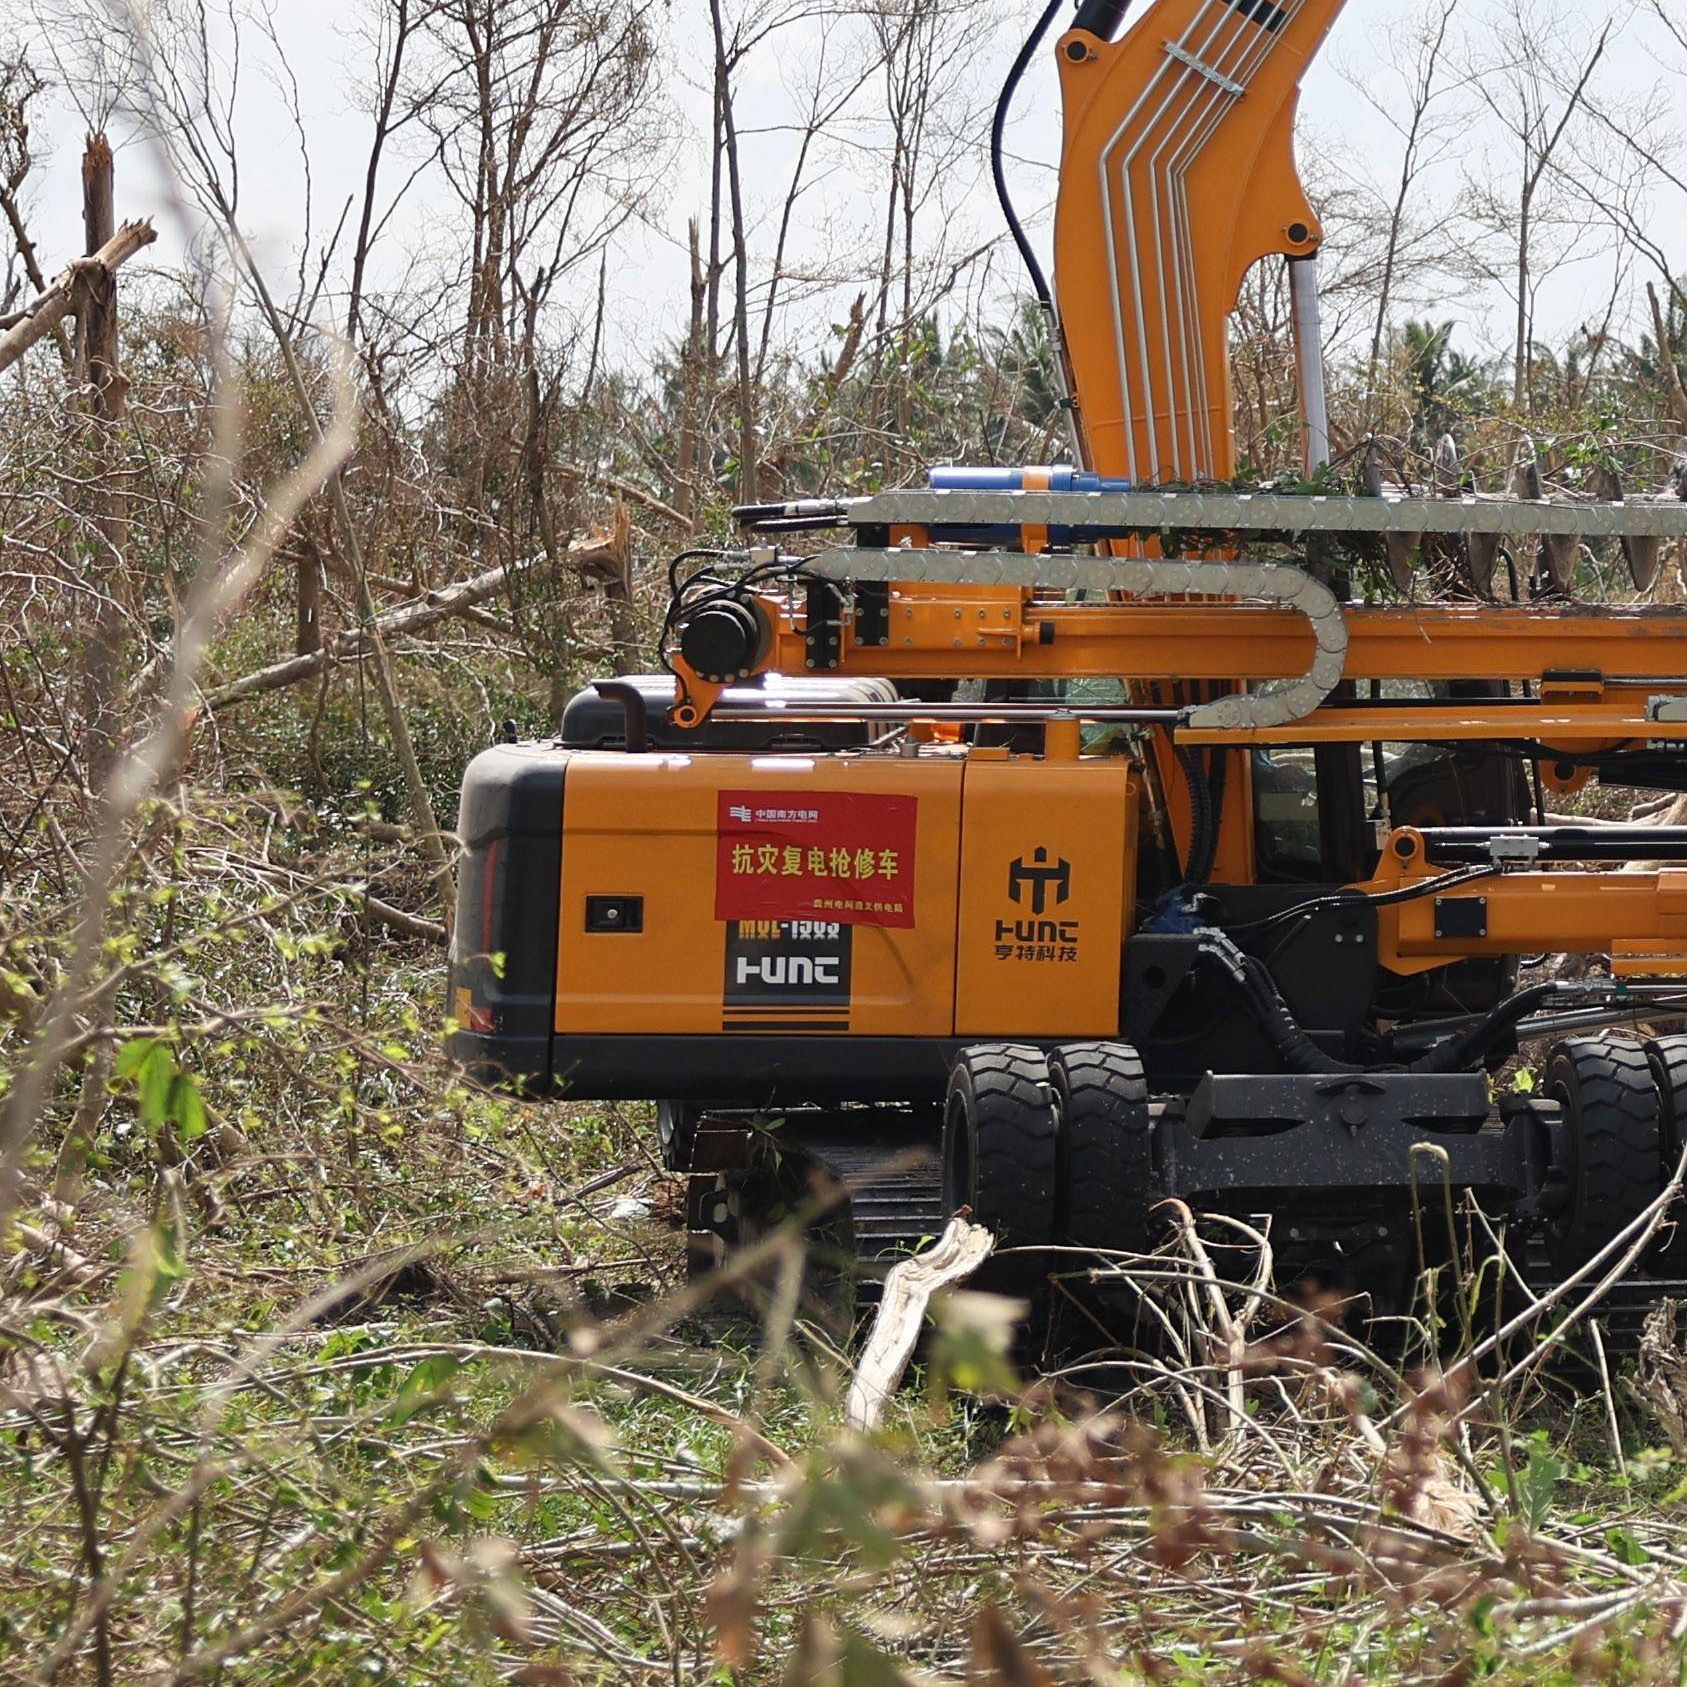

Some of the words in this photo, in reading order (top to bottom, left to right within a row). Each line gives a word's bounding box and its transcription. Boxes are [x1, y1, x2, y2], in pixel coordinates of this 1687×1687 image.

[755, 809, 818, 819] 中国南方电网
[732, 844, 899, 880] 抗灾复电抢修车
[995, 920, 1079, 942] HUNC
[994, 945, 1078, 962] 亨特科技
[737, 957, 839, 984] HUNC
